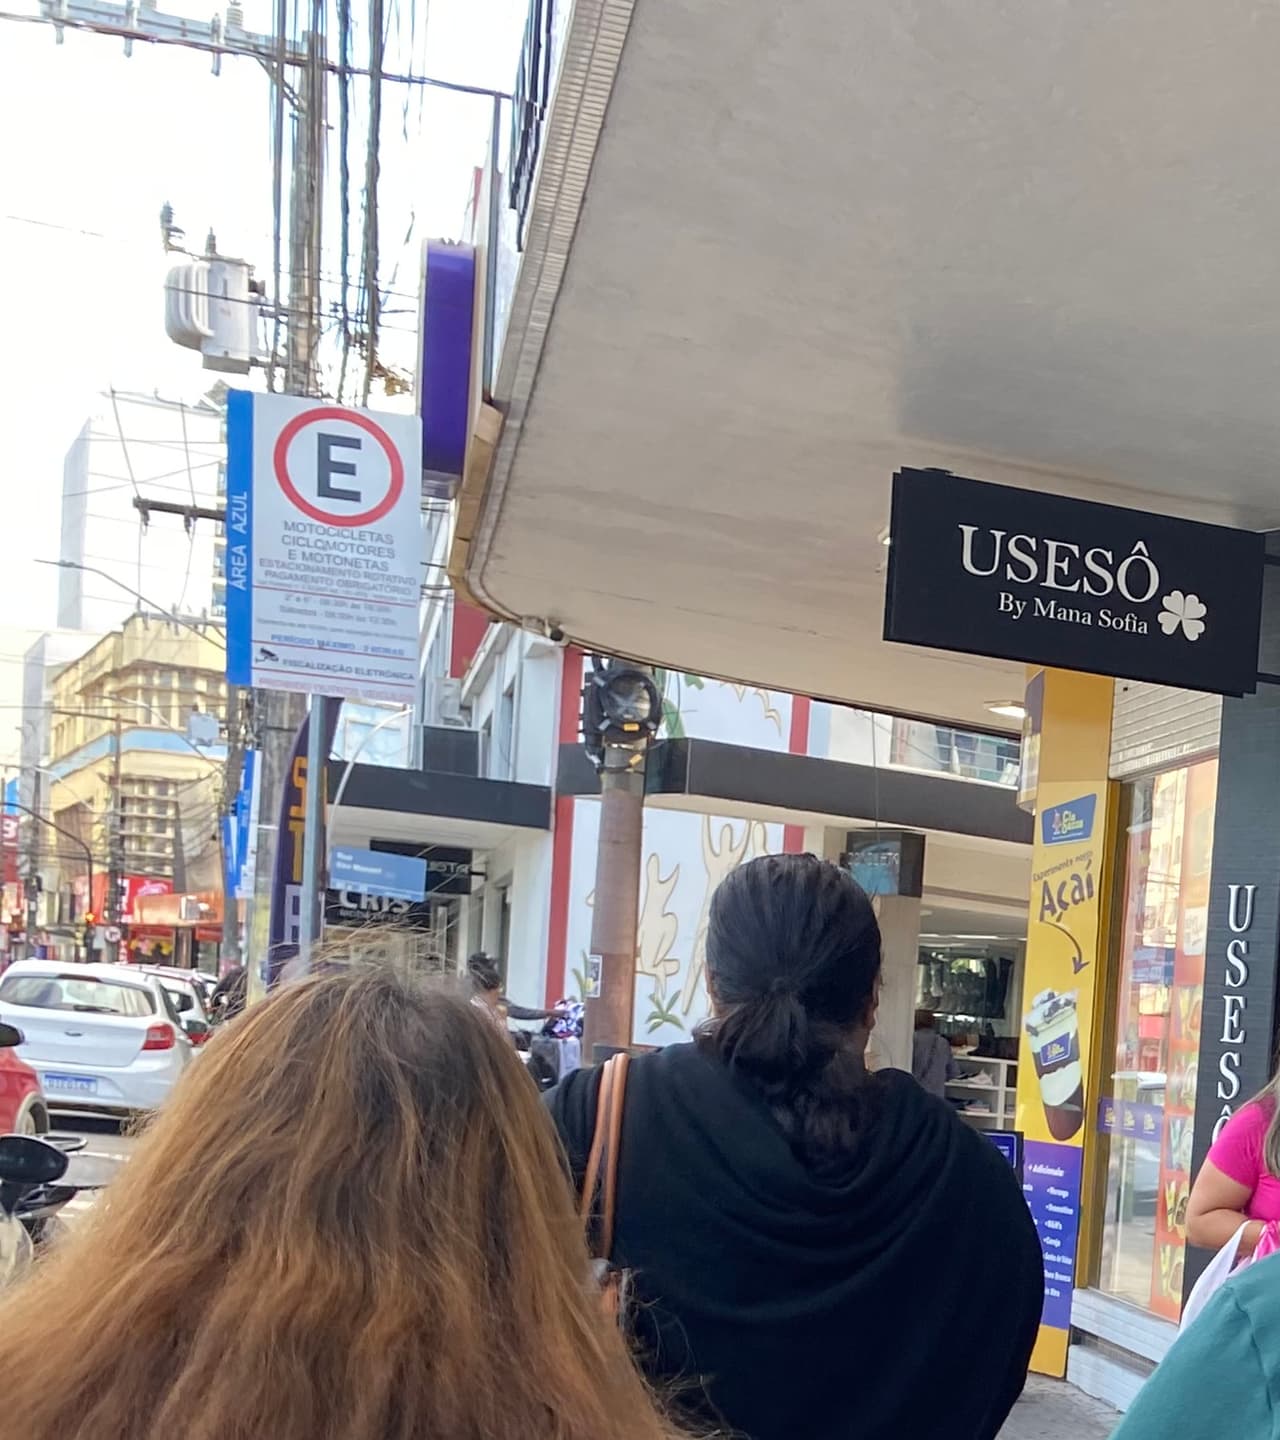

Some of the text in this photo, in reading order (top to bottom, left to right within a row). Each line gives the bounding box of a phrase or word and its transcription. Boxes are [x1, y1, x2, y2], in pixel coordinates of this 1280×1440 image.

[317, 432, 361, 502] E
[231, 490, 247, 591] ÁREA AZUL
[281, 534, 396, 559] CICLOMOTORES
[283, 520, 394, 545] MOTOCICLETAS
[259, 557, 417, 586] ESTACIONAMENTO ROTATIVO
[288, 549, 389, 572] E MOTONETAS
[958, 524, 1160, 603] USESÔ
[264, 569, 334, 587] PAGAMENTO
[998, 592, 1149, 635] By Mana Sofia
[282, 658, 353, 675] FISCALIZAÇÃO
[1040, 858, 1094, 923] Açaí
